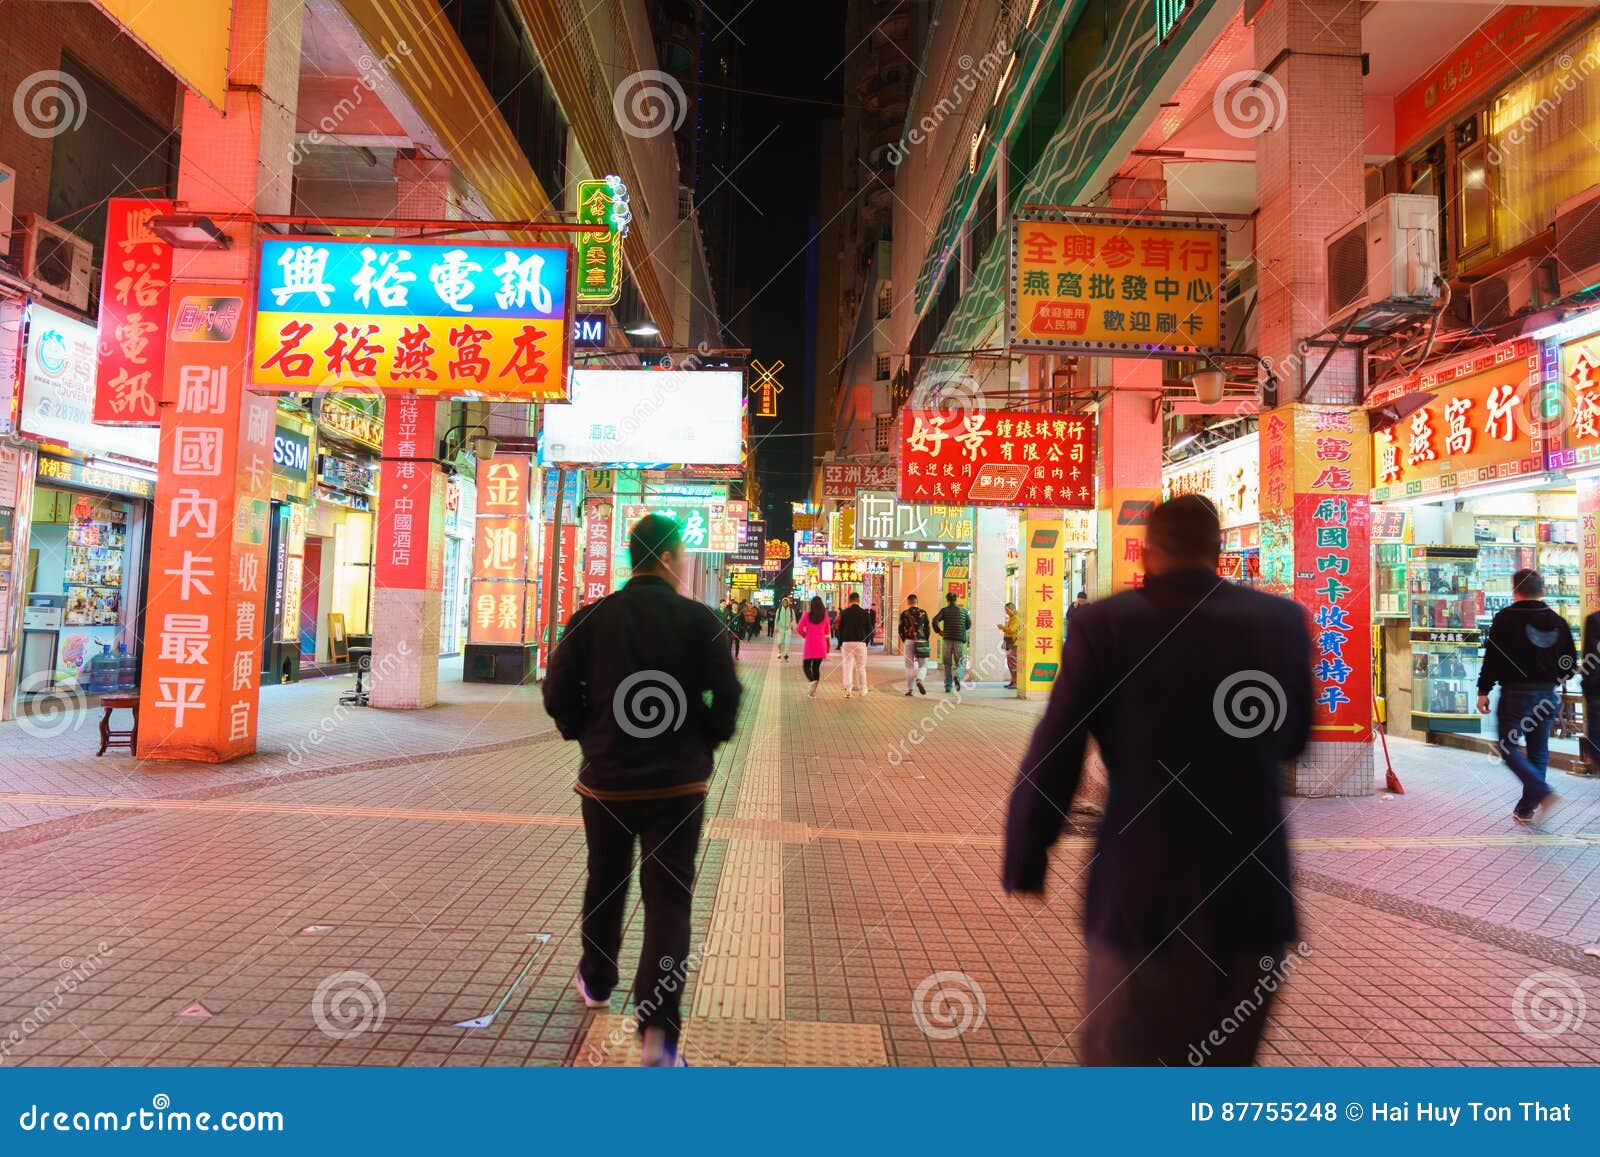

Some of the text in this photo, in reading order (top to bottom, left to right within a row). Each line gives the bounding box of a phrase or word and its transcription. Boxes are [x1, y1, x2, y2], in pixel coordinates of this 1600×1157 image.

[1023, 231, 1212, 273] 全興參茸行
[271, 245, 552, 314] 興裕電訊
[1023, 269, 1213, 304] 燕窩批發中心
[108, 209, 170, 417] 興裕電訊
[1103, 309, 1204, 336] 歡迎刷卡
[260, 320, 548, 384] 名裕燕窩店
[906, 414, 993, 461] 好景
[1407, 384, 1520, 465] 燕窩行
[273, 436, 308, 471] SSM
[1000, 442, 1084, 464] 有限公司
[915, 482, 962, 497] 人民幣
[1025, 485, 1090, 500] 消費特平
[155, 365, 228, 728] 刷國內卡最平
[938, 520, 972, 539] 火鍋
[1035, 557, 1055, 655] 刷卡最平
